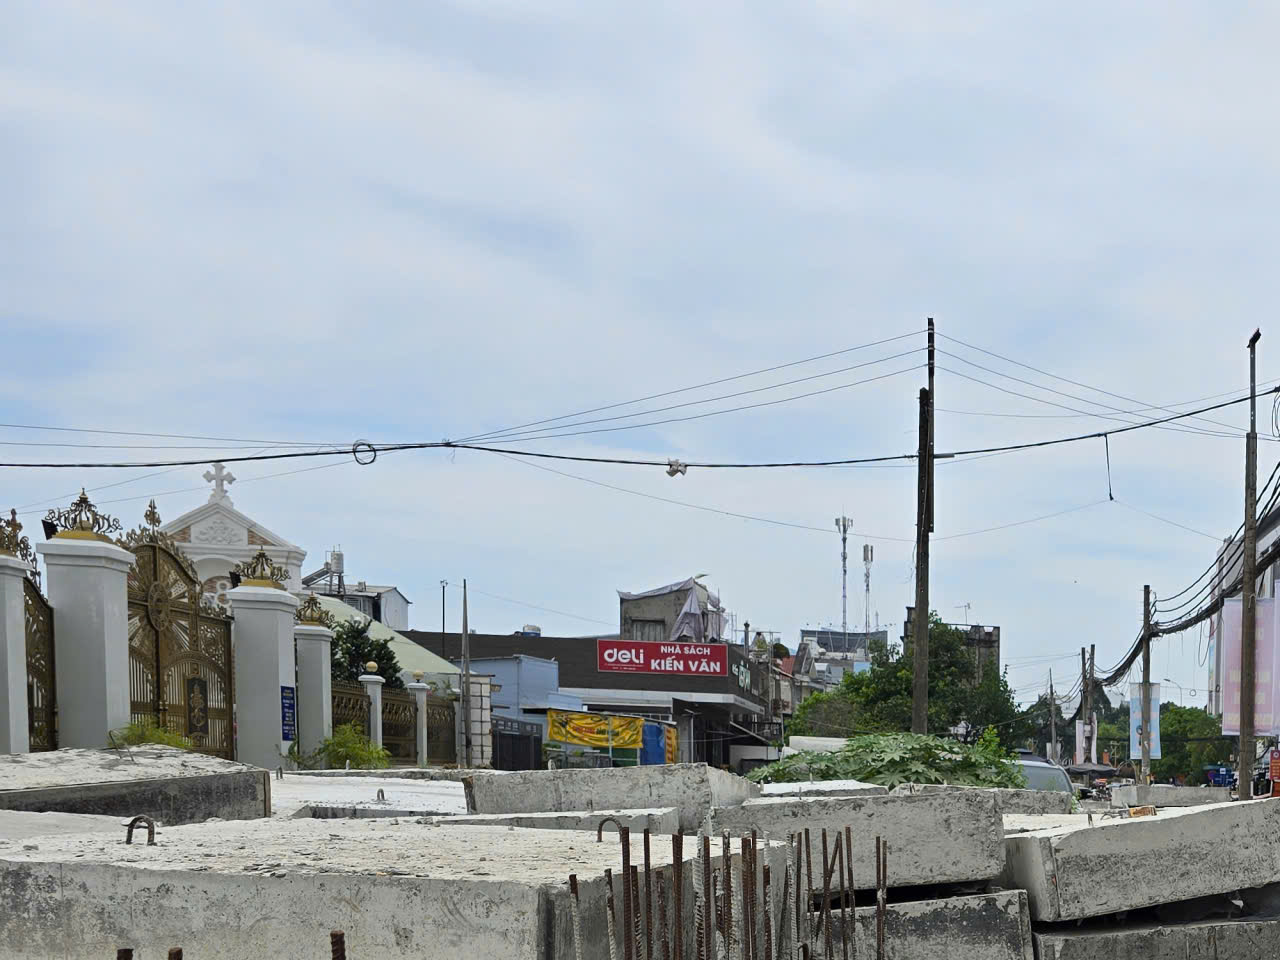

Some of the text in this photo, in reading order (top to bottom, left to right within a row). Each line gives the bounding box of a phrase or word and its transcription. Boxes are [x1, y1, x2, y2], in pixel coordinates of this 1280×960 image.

[660, 645, 711, 655] NHÀ SÁCH
[650, 656, 684, 672] KIẾN
[688, 658, 721, 673] VĂN
